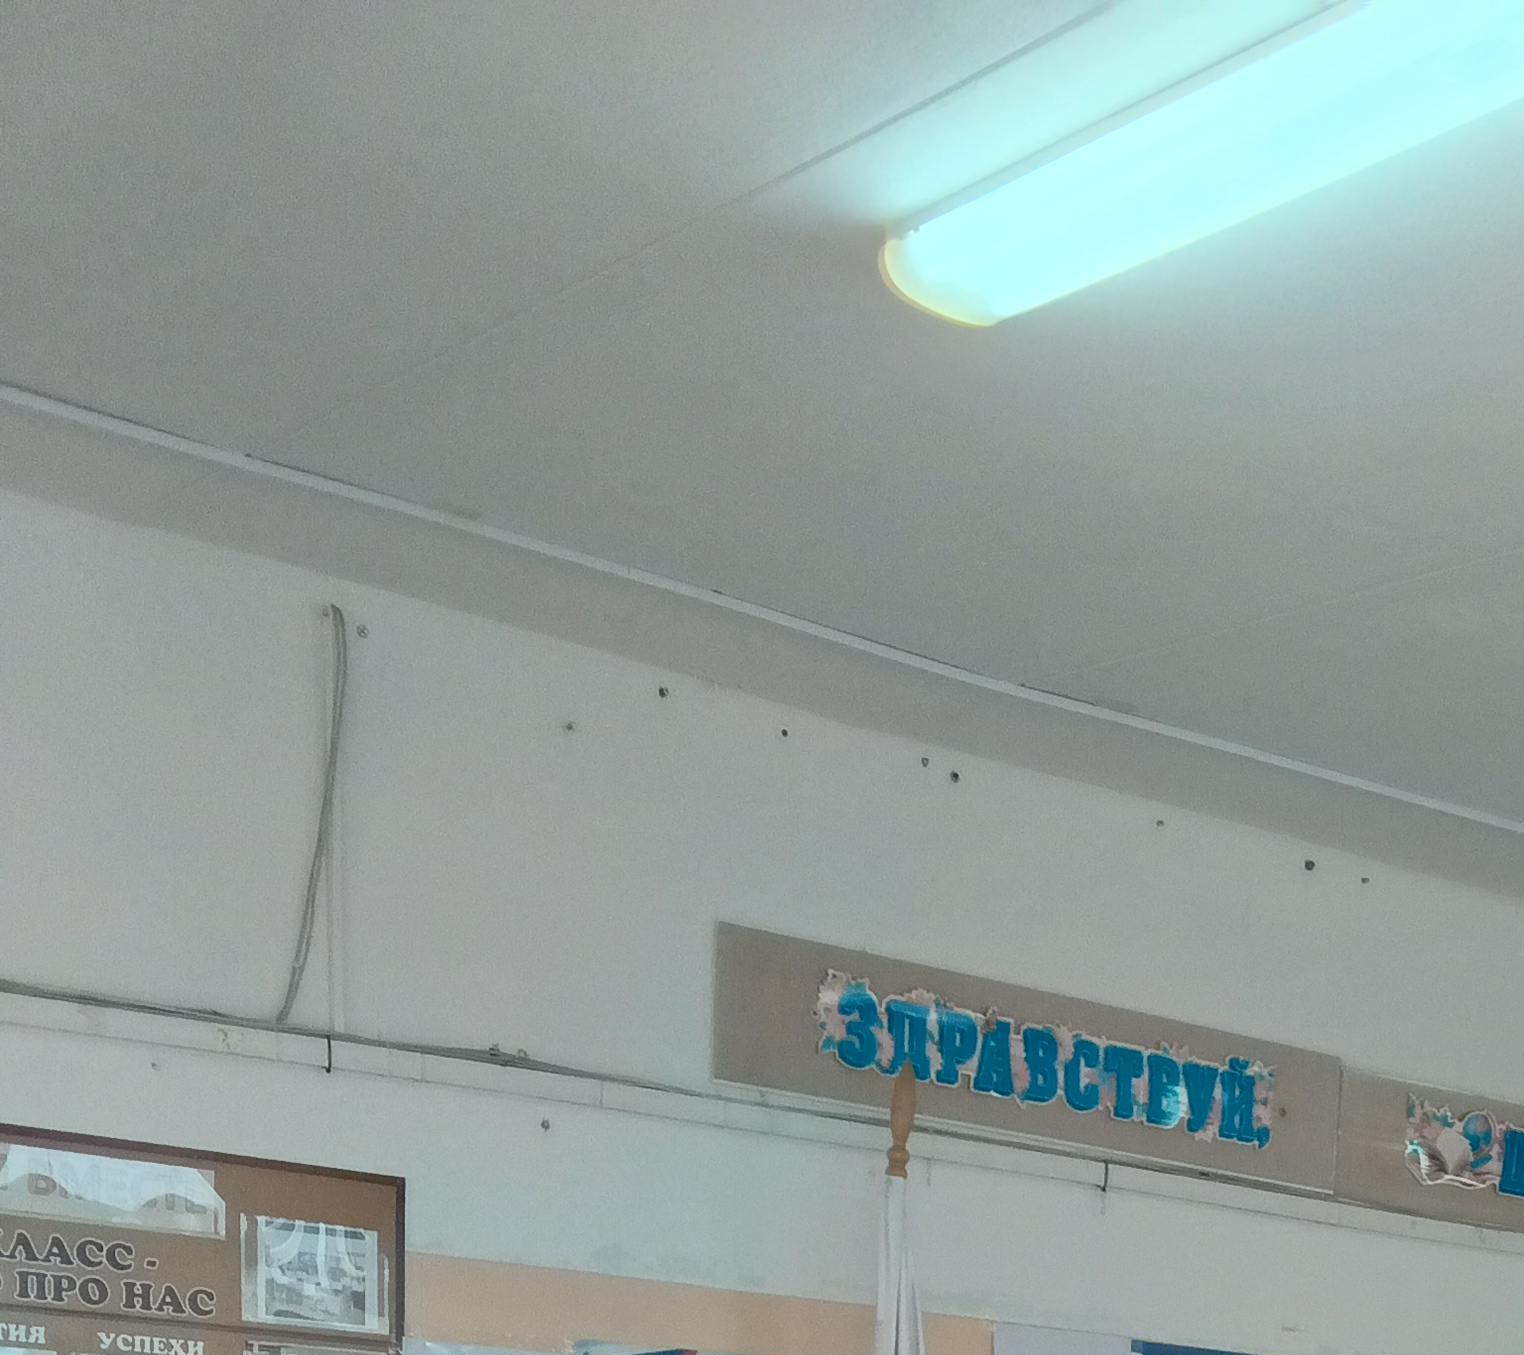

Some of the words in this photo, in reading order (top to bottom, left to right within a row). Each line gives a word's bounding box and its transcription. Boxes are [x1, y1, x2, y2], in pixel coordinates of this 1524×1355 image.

[838, 990, 1271, 1149] ЗДРАВСТВУЙ,
[0, 1229, 134, 1271] ЛАСС
[15, 1270, 109, 1306] ПРО
[121, 1280, 215, 1318] НАС
[0, 1323, 46, 1344] ТИЯ
